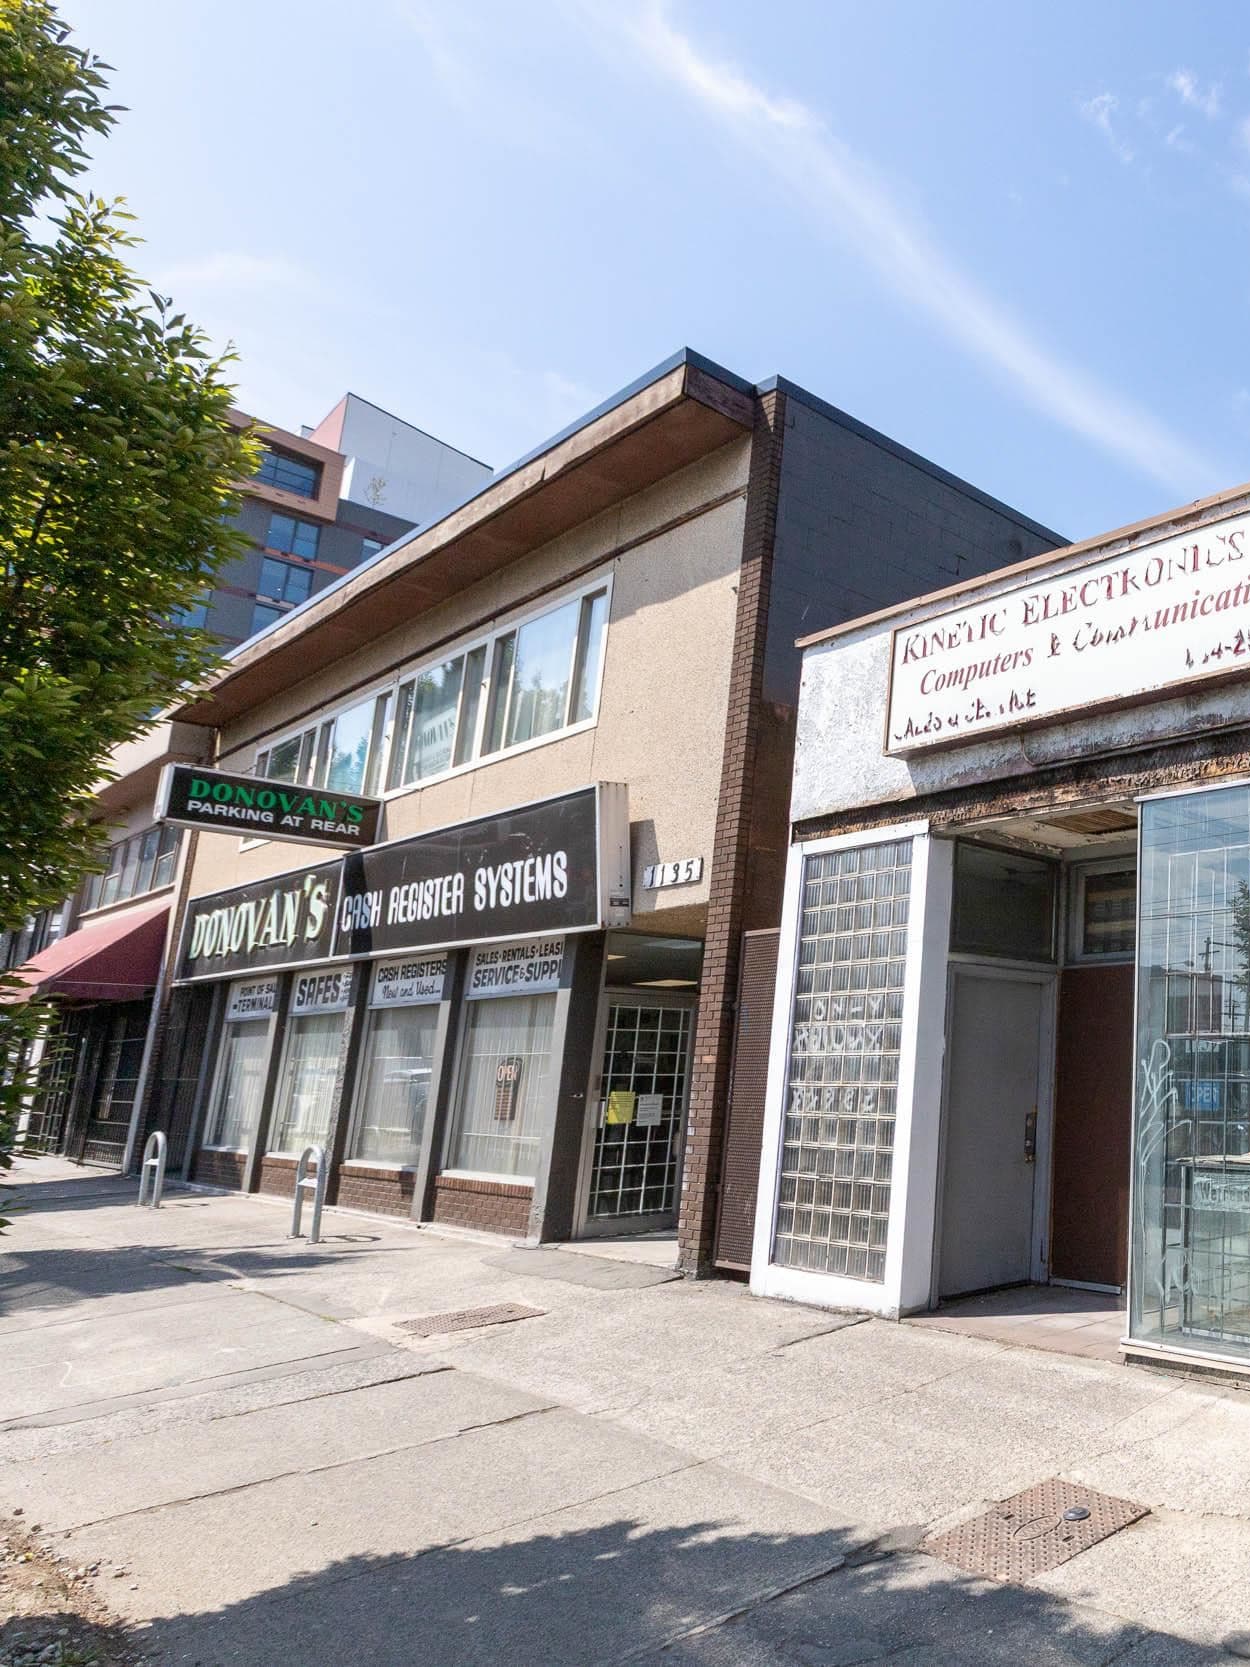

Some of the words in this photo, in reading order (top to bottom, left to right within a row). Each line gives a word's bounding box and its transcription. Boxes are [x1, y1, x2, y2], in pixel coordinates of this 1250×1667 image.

[902, 608, 1007, 666] KINETIC
[920, 647, 1034, 697] Computers
[187, 800, 274, 824] PARKING
[280, 815, 304, 828] AT
[311, 818, 360, 837] REAR
[188, 778, 365, 823] DONOVAN'S
[341, 889, 384, 932] CASH
[387, 872, 465, 926] REGISTER
[474, 850, 568, 912] SYSTEMS
[188, 874, 331, 961] DONOVAN'S
[296, 973, 342, 1007] SAFES
[378, 966, 399, 983] CASH
[399, 958, 448, 981] REGISTERS
[400, 981, 414, 997] and
[473, 964, 520, 989] SERVICE
